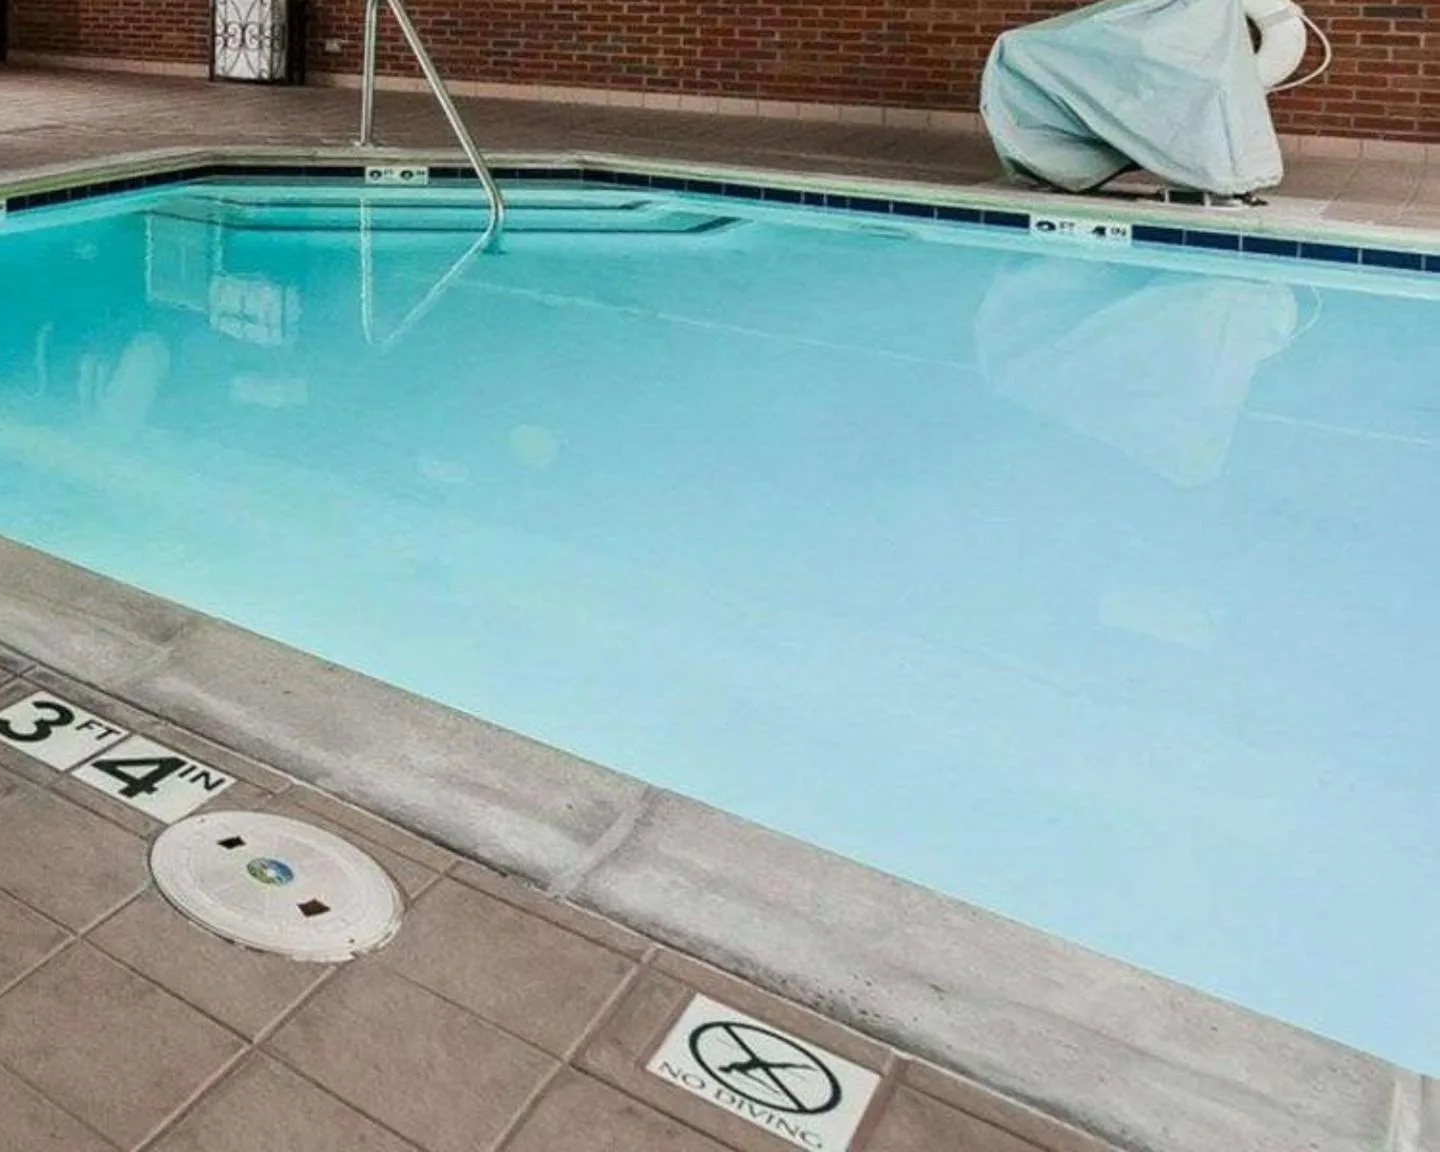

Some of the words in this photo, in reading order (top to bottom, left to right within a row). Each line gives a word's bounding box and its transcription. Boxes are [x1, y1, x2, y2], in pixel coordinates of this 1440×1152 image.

[76, 719, 122, 741] FT
[90, 756, 187, 798] 4
[177, 765, 226, 791] IN
[660, 1061, 706, 1090] NO
